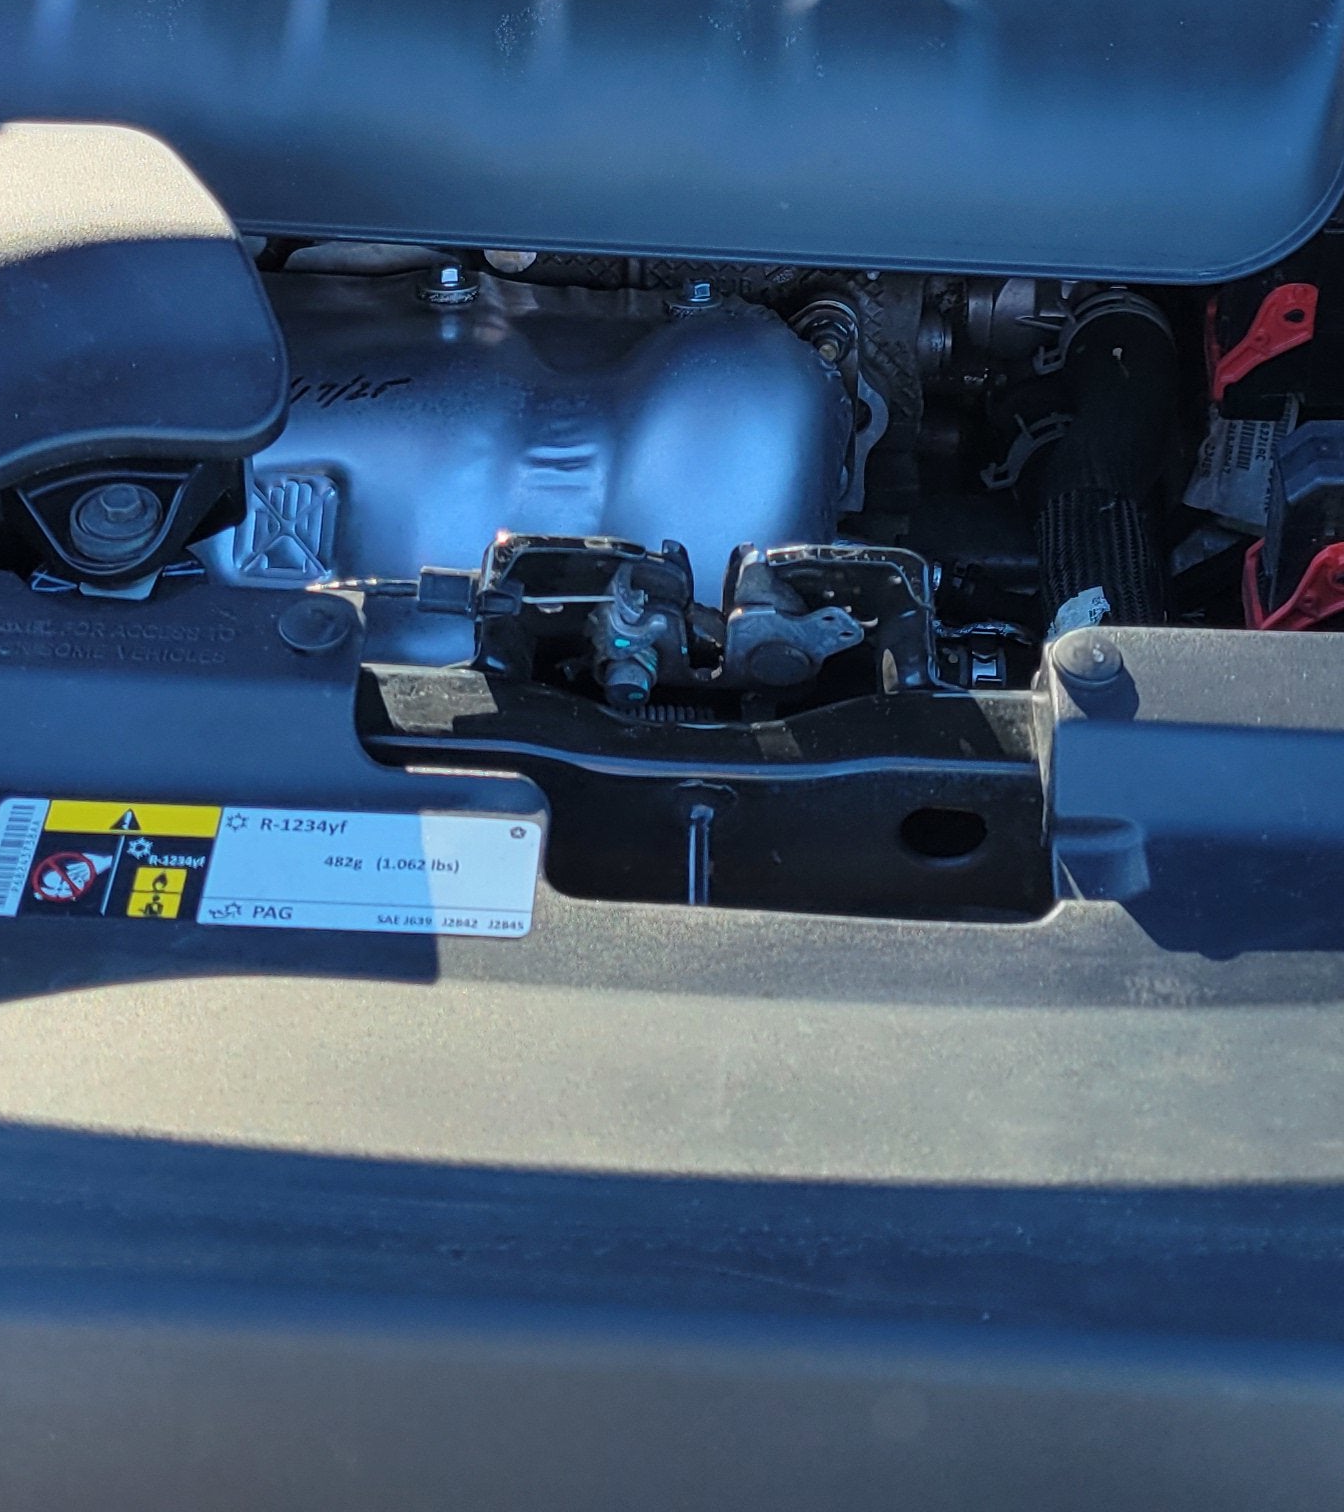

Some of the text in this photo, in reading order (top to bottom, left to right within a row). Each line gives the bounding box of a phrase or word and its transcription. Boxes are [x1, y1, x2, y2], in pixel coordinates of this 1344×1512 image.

[111, 622, 201, 642] ACCESS
[209, 624, 236, 643] TO
[36, 642, 105, 660] SOME
[115, 644, 226, 666] VEHICLES
[259, 816, 348, 837] R-1234yf
[323, 855, 460, 874] 482g (1.062 lbs)
[252, 905, 293, 920] PAG
[376, 914, 401, 925] SAE
[403, 914, 433, 927] J639
